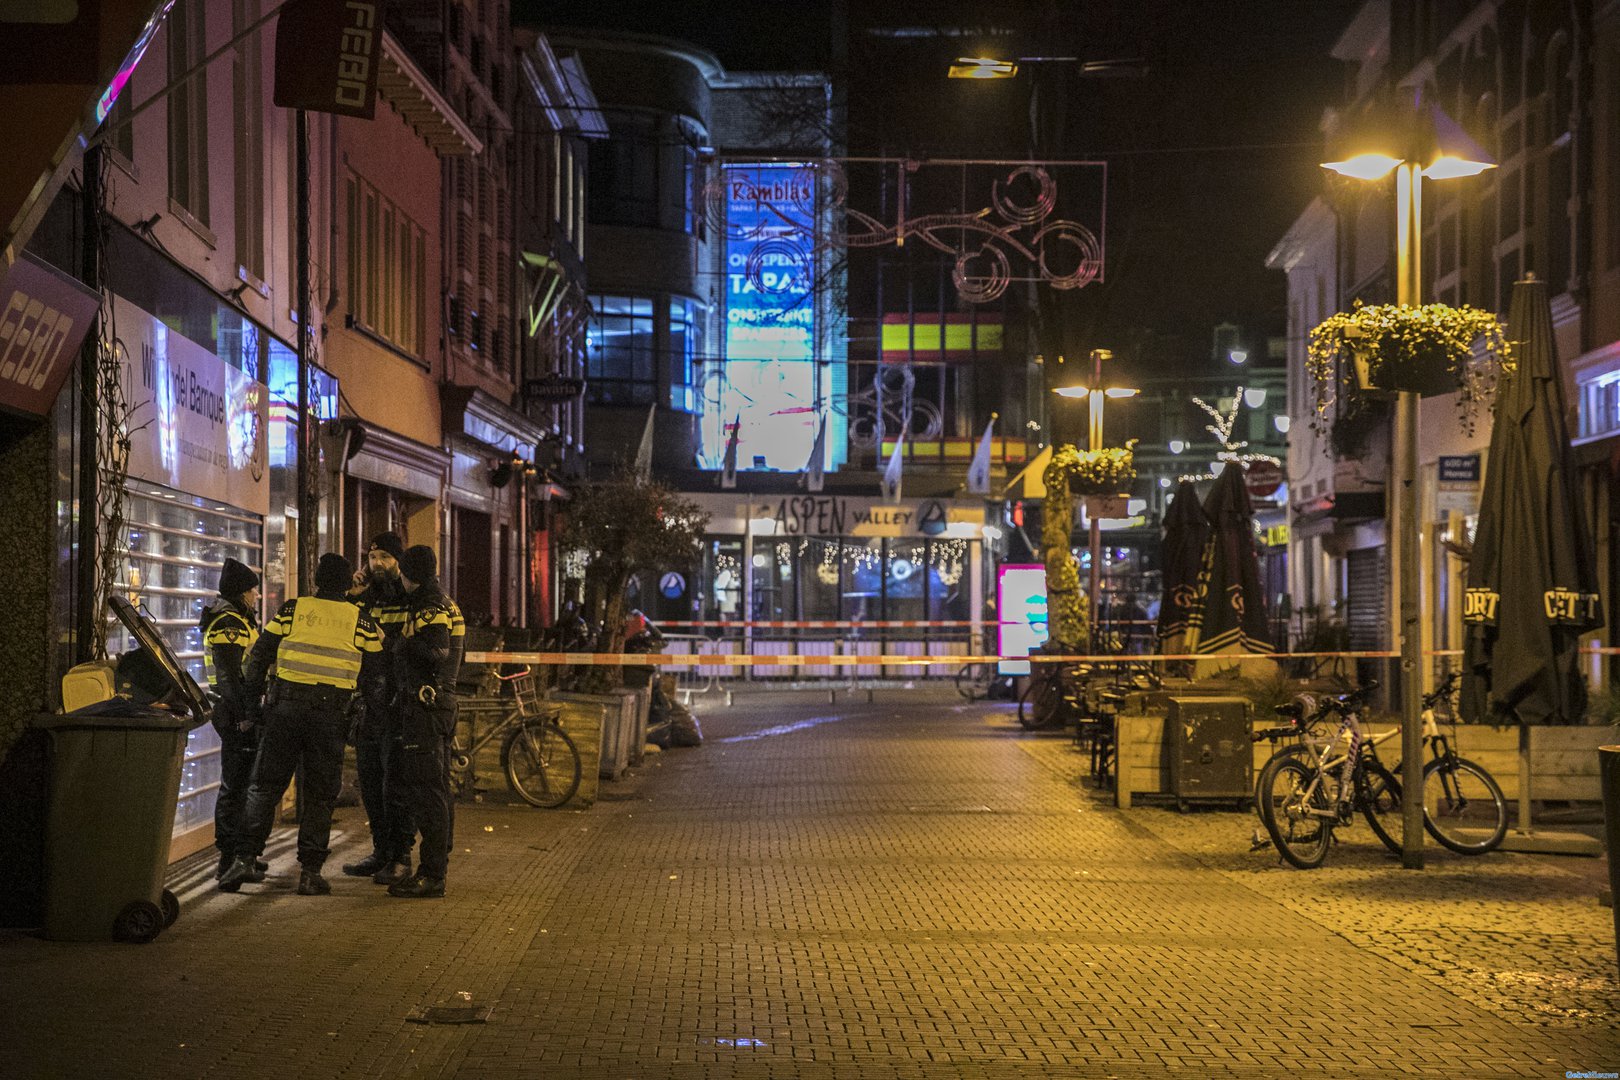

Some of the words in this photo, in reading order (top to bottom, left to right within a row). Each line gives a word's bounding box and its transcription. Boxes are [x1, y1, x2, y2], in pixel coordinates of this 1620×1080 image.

[335, 2, 375, 108] FEBO
[732, 180, 811, 202] Ramblas
[0, 290, 74, 391] FEBO
[190, 370, 224, 430] Barrique
[530, 383, 577, 395] Bavaria
[774, 496, 846, 534] ASPEN
[853, 511, 913, 525] VALLEY
